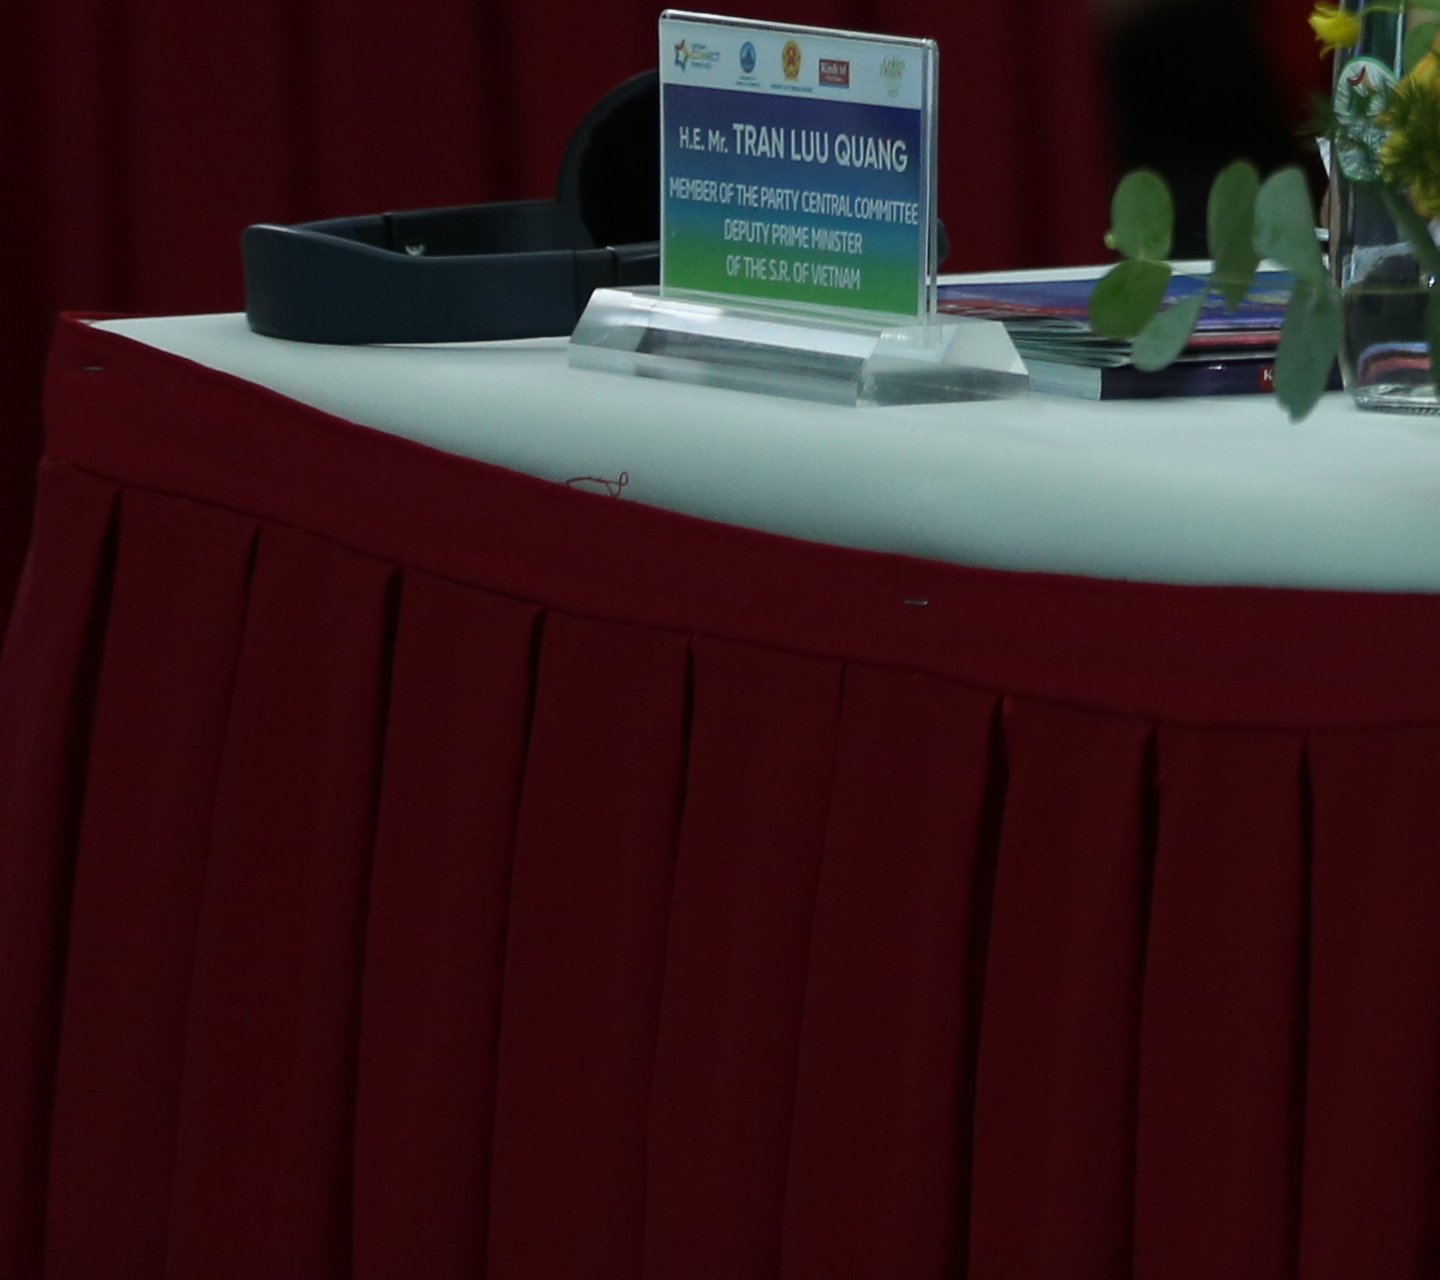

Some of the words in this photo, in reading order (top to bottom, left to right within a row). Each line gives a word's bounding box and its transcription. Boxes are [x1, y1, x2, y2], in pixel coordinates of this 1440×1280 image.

[679, 126, 705, 151] H.E.
[708, 129, 729, 153] Mr.
[732, 122, 785, 159] TRAN
[790, 128, 830, 165] LUU
[834, 133, 909, 173] QUANG
[669, 177, 718, 203] MEMBER
[719, 182, 733, 204] OF
[735, 184, 759, 208] THE
[760, 187, 800, 212] PARTY
[802, 191, 853, 218] CENTRAL
[854, 197, 919, 225] COMMITTEE
[724, 218, 770, 245] DEPUTY
[771, 223, 810, 248] PRIME
[811, 228, 863, 255] MINISTER
[726, 255, 741, 276] OF
[742, 256, 767, 279] THE
[769, 260, 791, 282] S.R.
[794, 262, 809, 284] OF
[811, 264, 861, 290] VIETNAM
